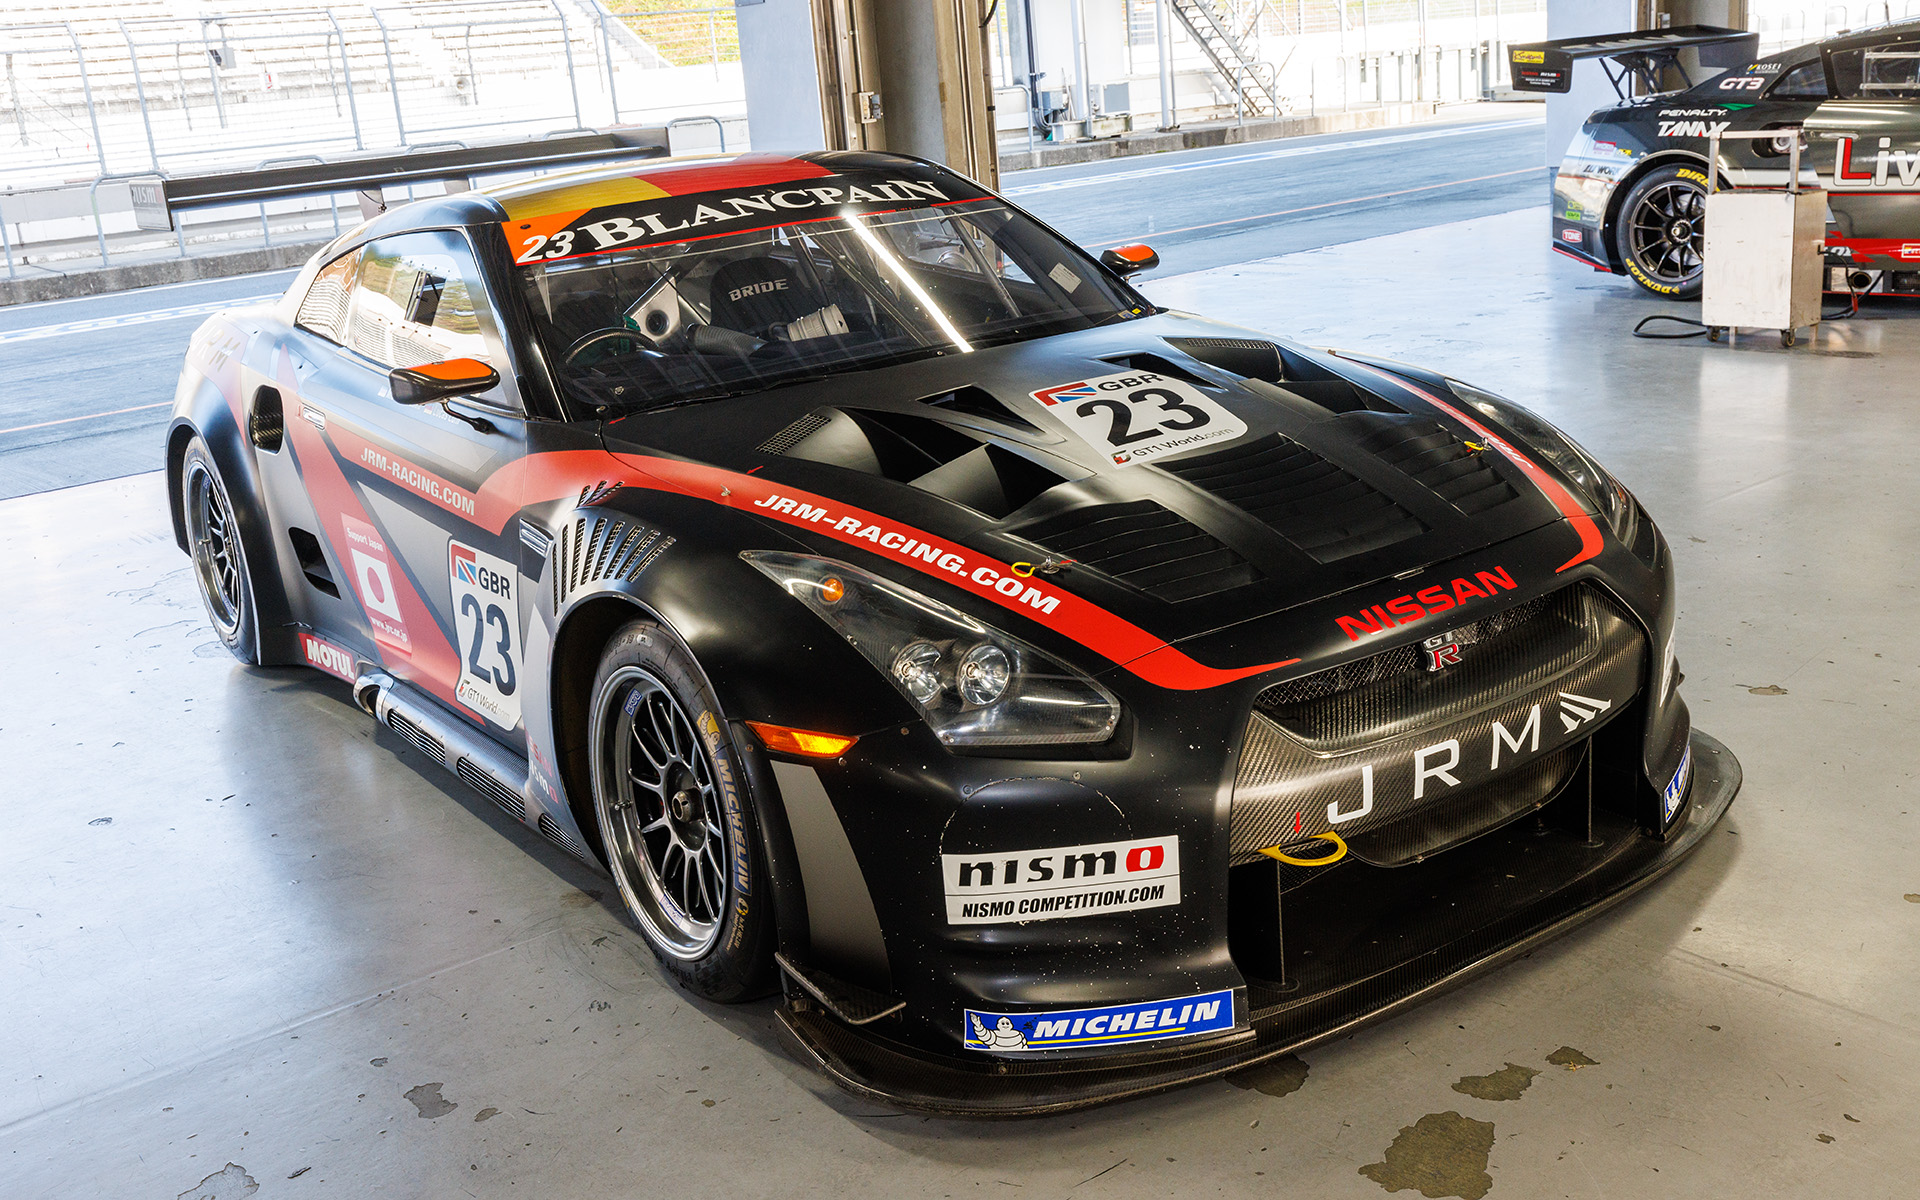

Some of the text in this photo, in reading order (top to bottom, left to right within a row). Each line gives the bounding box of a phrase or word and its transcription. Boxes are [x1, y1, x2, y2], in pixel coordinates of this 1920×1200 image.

[1719, 77, 1766, 90] GT3
[1658, 109, 1727, 117] PENALTY
[1834, 136, 1920, 187] Liv
[516, 179, 950, 263] 23 BLANCPAIN
[1564, 231, 1581, 241] TONE
[728, 279, 789, 301] BRIDE
[1625, 258, 1673, 293] DUNLOP
[1098, 374, 1164, 391] GBR
[1076, 388, 1211, 447] 23
[1133, 428, 1234, 457] GT1 World.com
[360, 448, 475, 516] JRM-RACING.COM
[754, 495, 1061, 615] JRM-RACING.COM
[478, 567, 511, 600] GBR
[1335, 566, 1518, 642] NISSAN
[306, 638, 355, 680] MOTUL
[461, 593, 517, 696] 23
[467, 687, 480, 702] GT1
[1327, 704, 1541, 824] JRM
[717, 758, 750, 890] MICHELIN
[958, 845, 1165, 887] nismo
[962, 884, 1165, 918] NISMO COMPETITION.COM
[1033, 1000, 1221, 1038] MICHELIN
